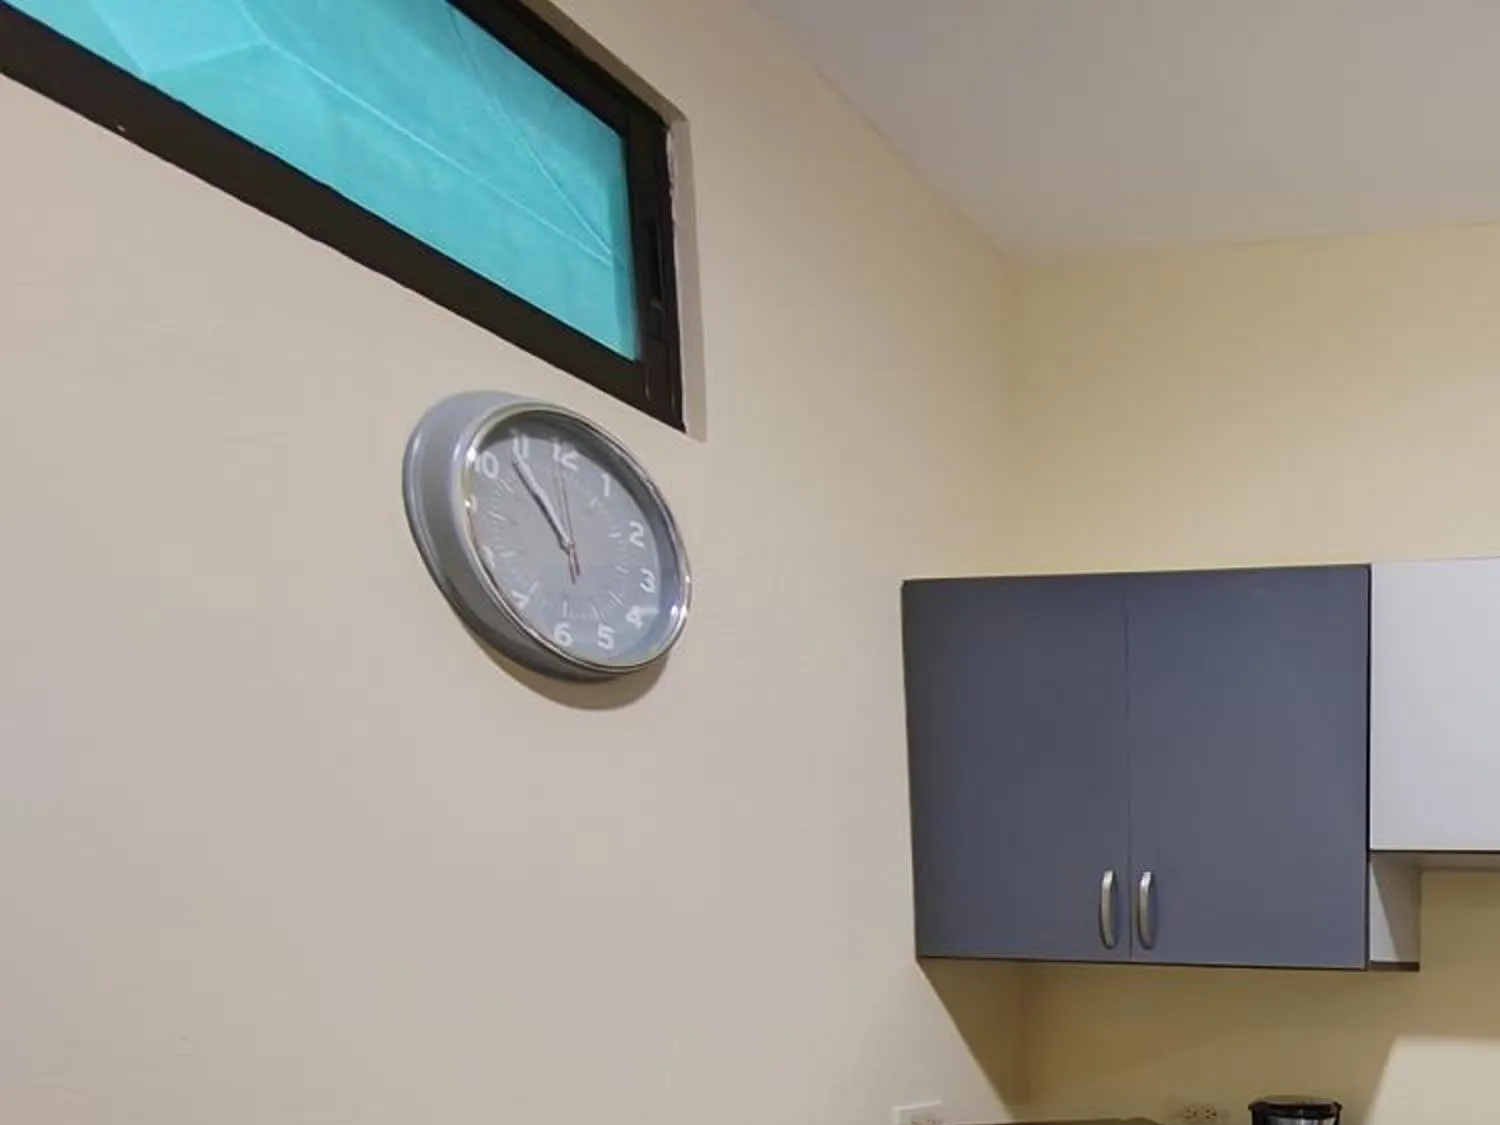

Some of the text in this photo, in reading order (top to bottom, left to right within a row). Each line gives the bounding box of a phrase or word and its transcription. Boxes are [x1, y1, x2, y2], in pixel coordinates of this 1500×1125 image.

[474, 453, 498, 477] 10
[552, 436, 579, 471] 12
[600, 473, 611, 497] 1
[628, 521, 645, 548] 2
[639, 568, 656, 593] 3
[625, 606, 643, 629] 4
[553, 622, 574, 647] 6
[597, 624, 617, 650] 5
